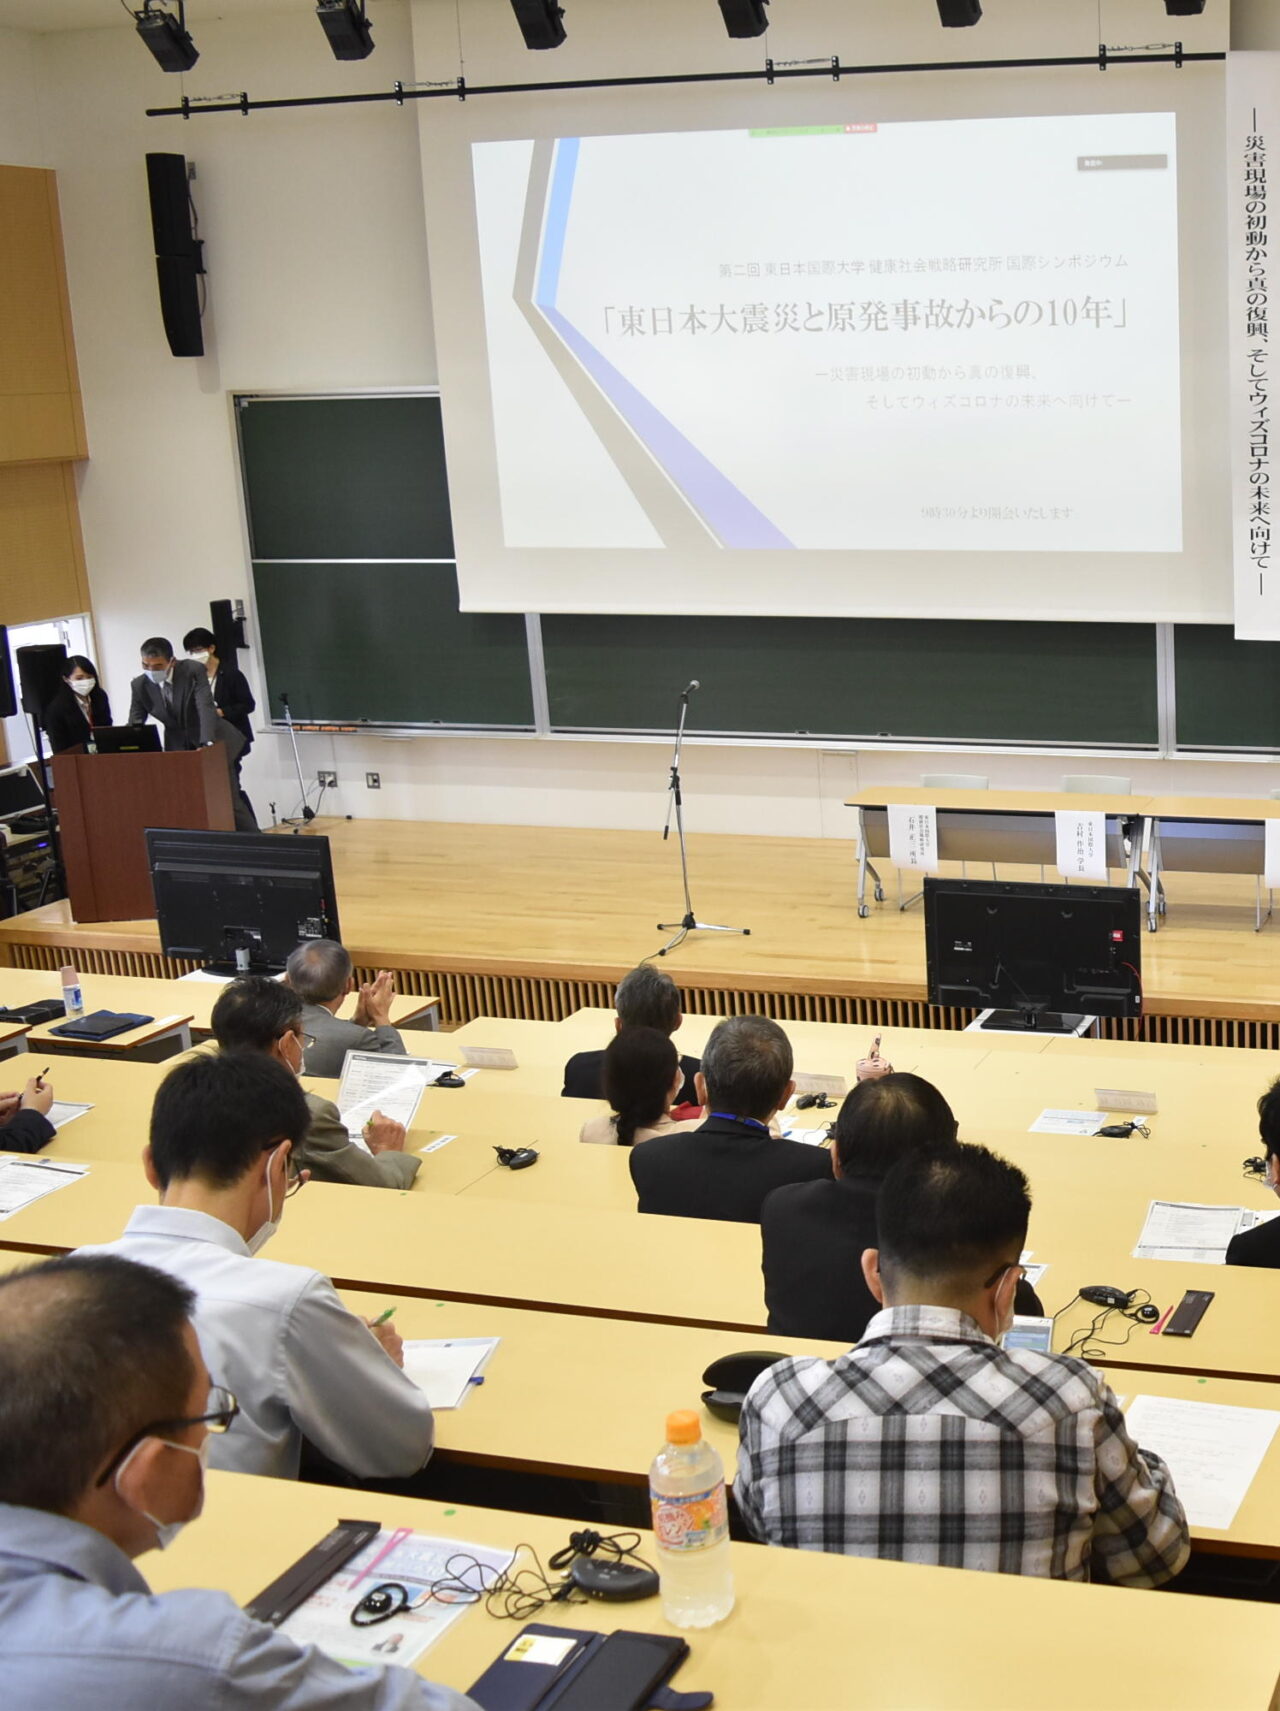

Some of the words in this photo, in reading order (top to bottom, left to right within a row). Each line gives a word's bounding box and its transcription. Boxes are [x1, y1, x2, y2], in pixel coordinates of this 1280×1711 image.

[719, 262, 761, 278] 第二回
[765, 259, 866, 277] 東日本国際大学
[869, 256, 1003, 275] 健康社会戦略研究所
[1006, 253, 1129, 272] 国際シンポジウム
[602, 295, 1128, 338] 「東日本大震災と原発事故からの10年」
